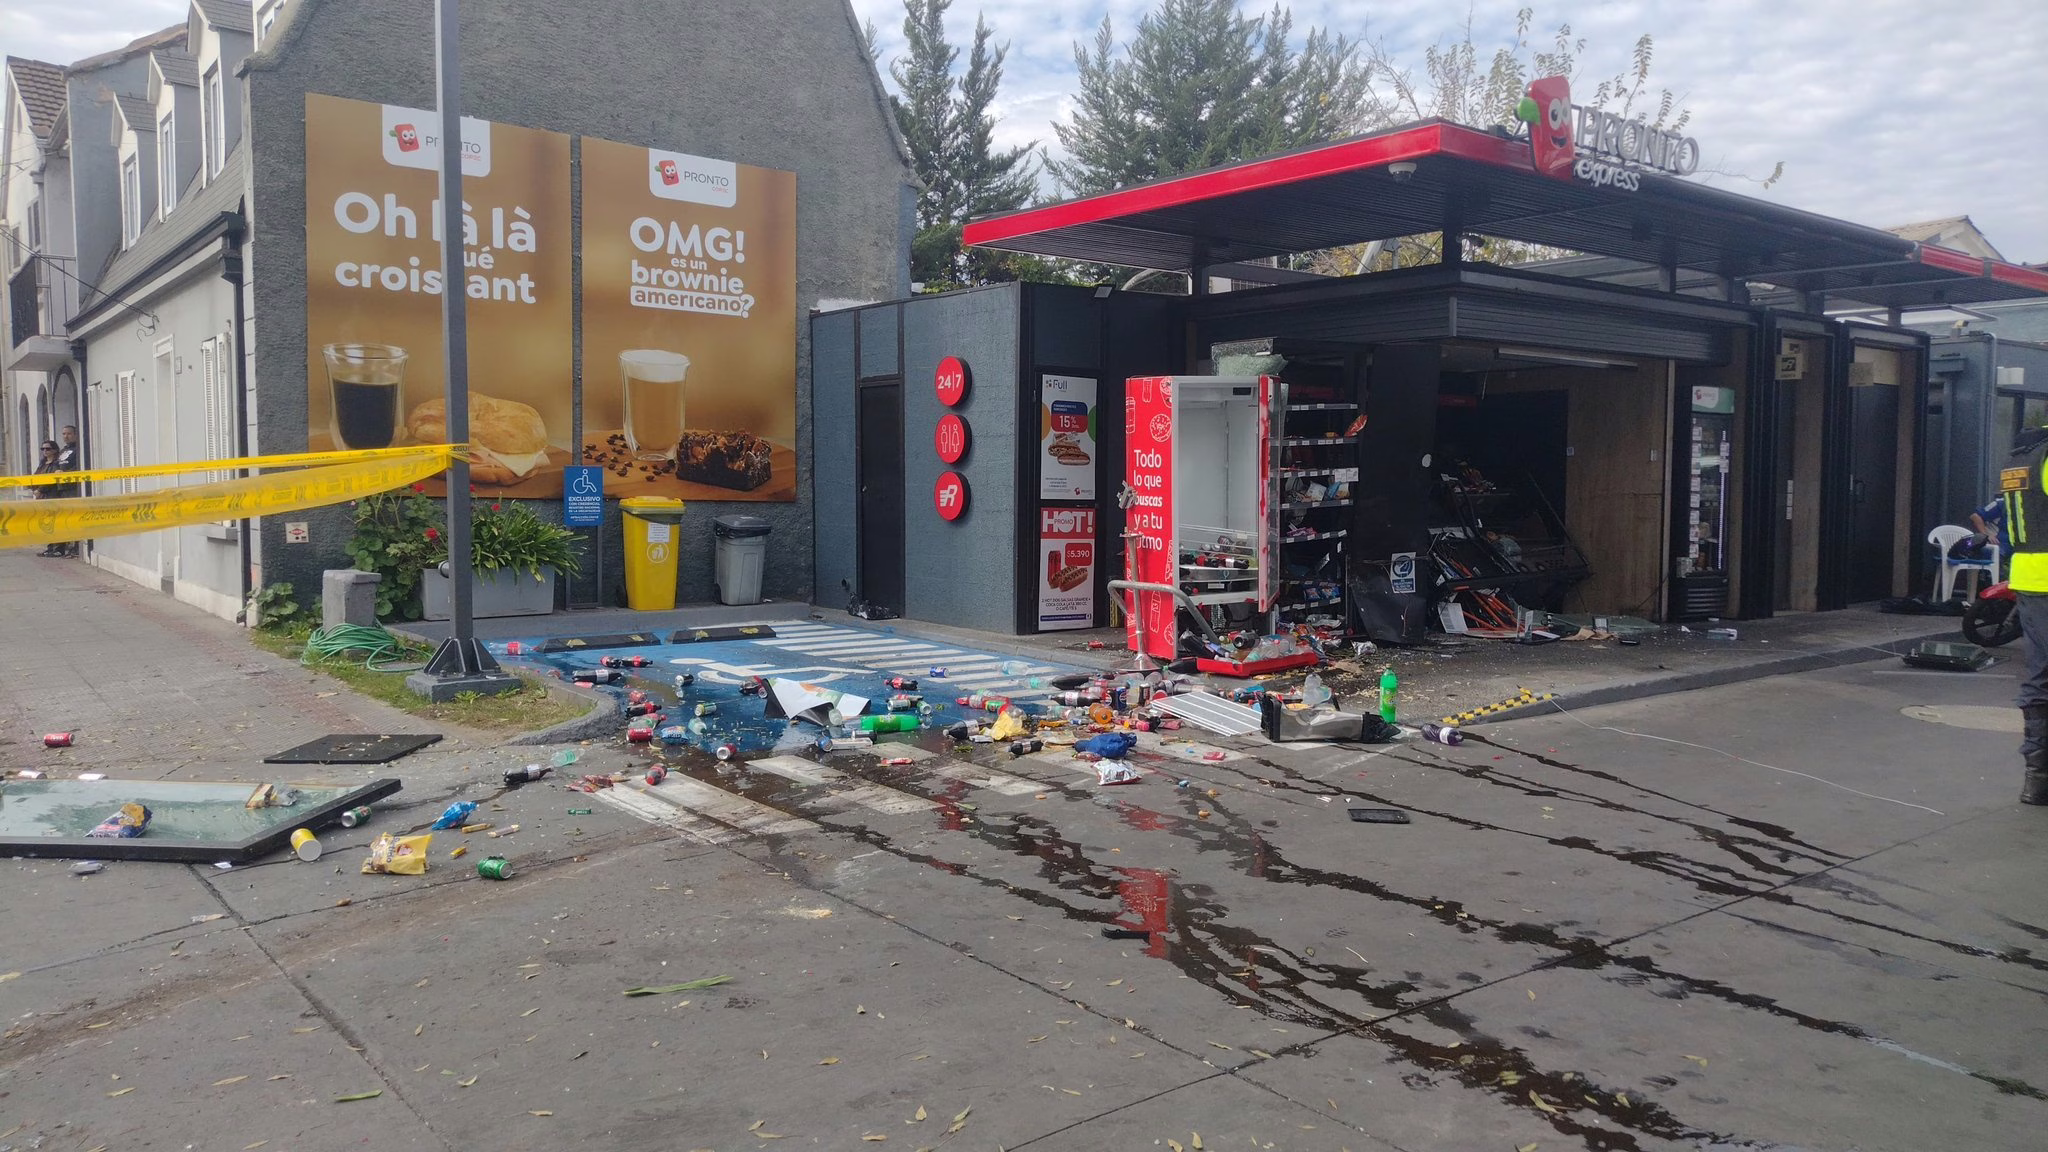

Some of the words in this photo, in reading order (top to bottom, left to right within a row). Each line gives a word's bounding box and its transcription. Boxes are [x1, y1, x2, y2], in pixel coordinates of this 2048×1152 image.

[1576, 105, 1700, 176] PRONTO
[684, 171, 729, 187] PRONTO
[1575, 158, 1641, 192] express
[334, 192, 417, 239] Oh
[492, 205, 536, 253] là
[629, 216, 746, 264] OMG!
[463, 245, 495, 270] ué
[671, 257, 687, 268] es
[690, 259, 708, 271] un
[335, 256, 537, 304] croisant
[631, 259, 744, 295] brownie
[634, 289, 755, 319] americano?
[1133, 448, 1162, 469] Todo
[1133, 469, 1142, 487] lo
[1144, 474, 1162, 490] que
[1042, 510, 1094, 534] HOT!
[1134, 513, 1141, 531] y
[1142, 514, 1149, 528] a
[1151, 511, 1163, 530] tu
[1066, 550, 1090, 558] $5.390
